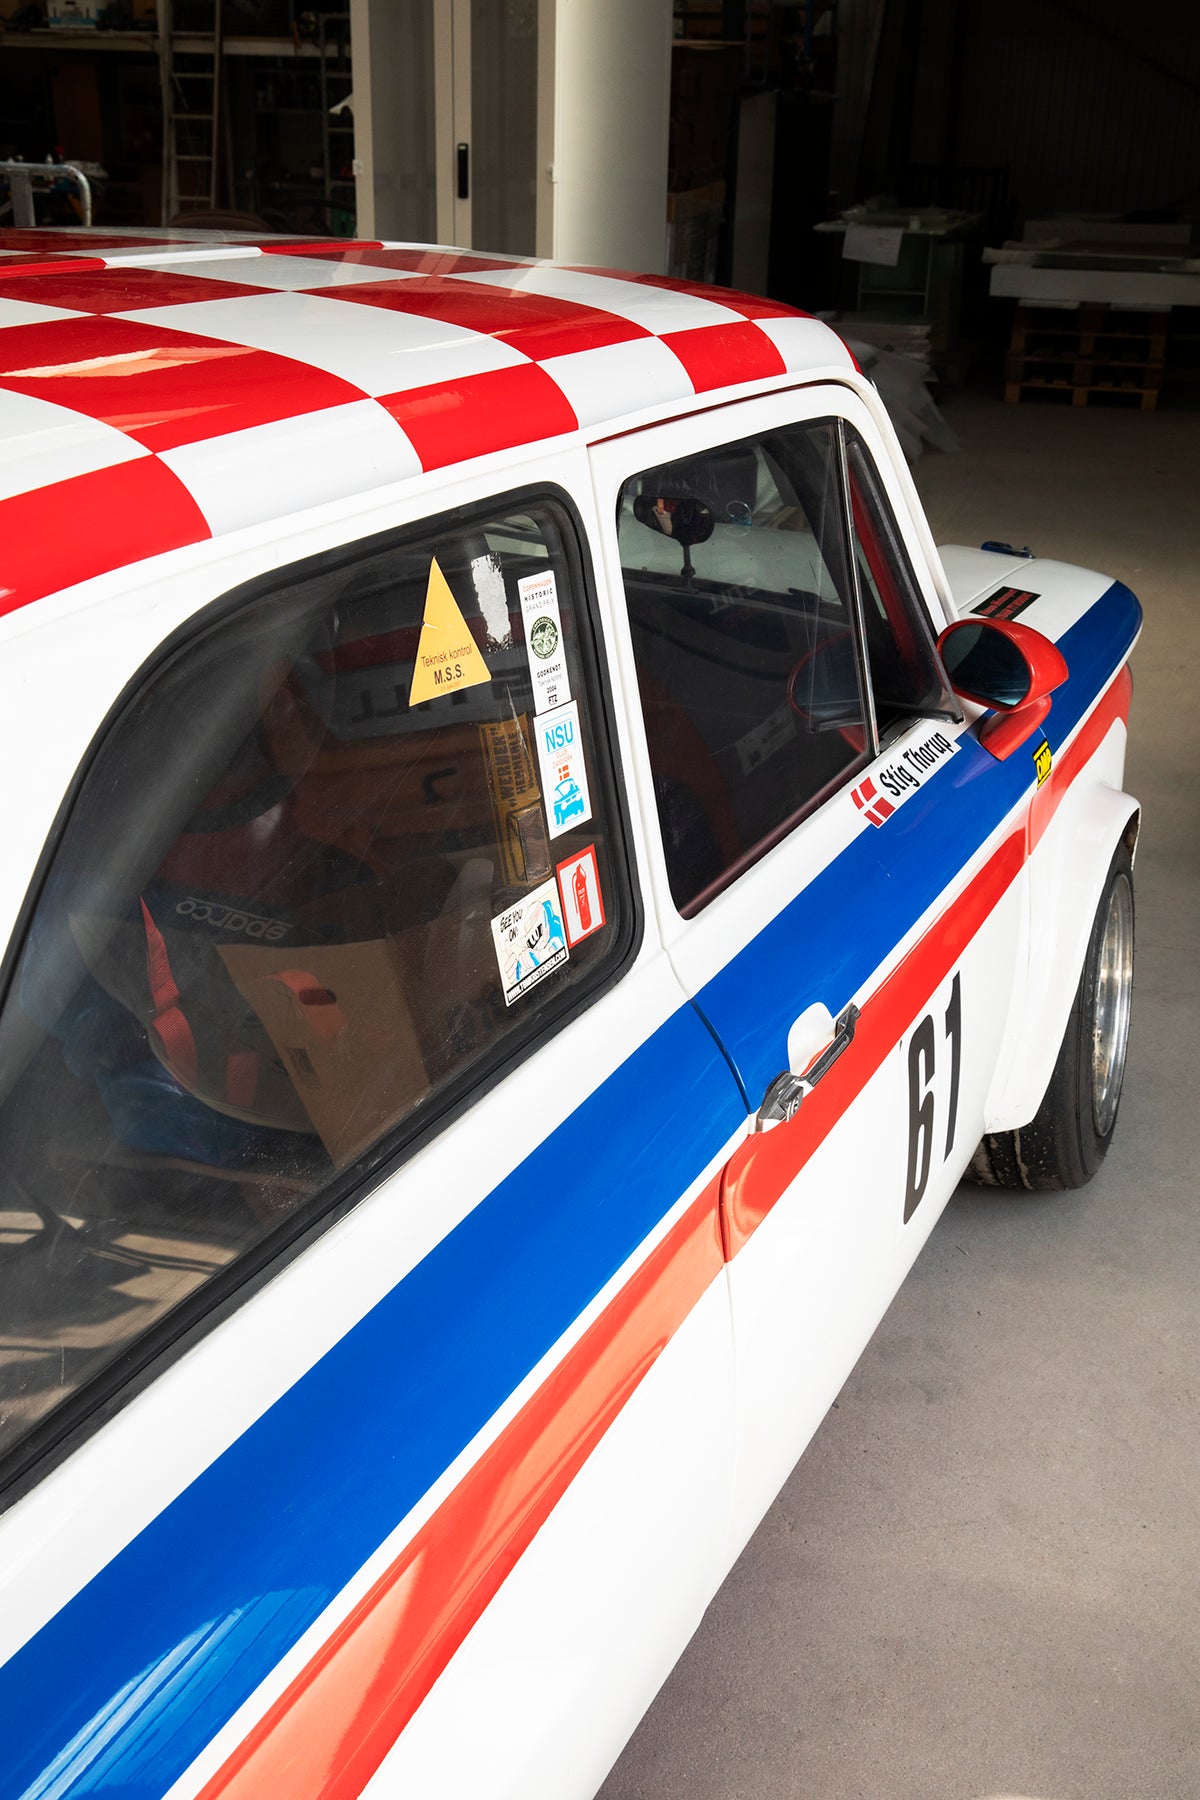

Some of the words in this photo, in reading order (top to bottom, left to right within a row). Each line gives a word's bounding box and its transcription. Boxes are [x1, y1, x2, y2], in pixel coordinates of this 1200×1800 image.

[524, 588, 553, 602] HISTORIC
[421, 651, 448, 667] Teknisk
[449, 643, 473, 660] kontrol
[434, 664, 465, 685] M.S.S.
[548, 694, 558, 704] FTZ
[545, 721, 574, 752] NSU
[879, 764, 921, 797] Stig
[902, 732, 955, 774] Thorup
[176, 900, 288, 940] sparco
[500, 914, 512, 932] SEE
[512, 909, 523, 924] YOU
[903, 970, 961, 1225] 61
